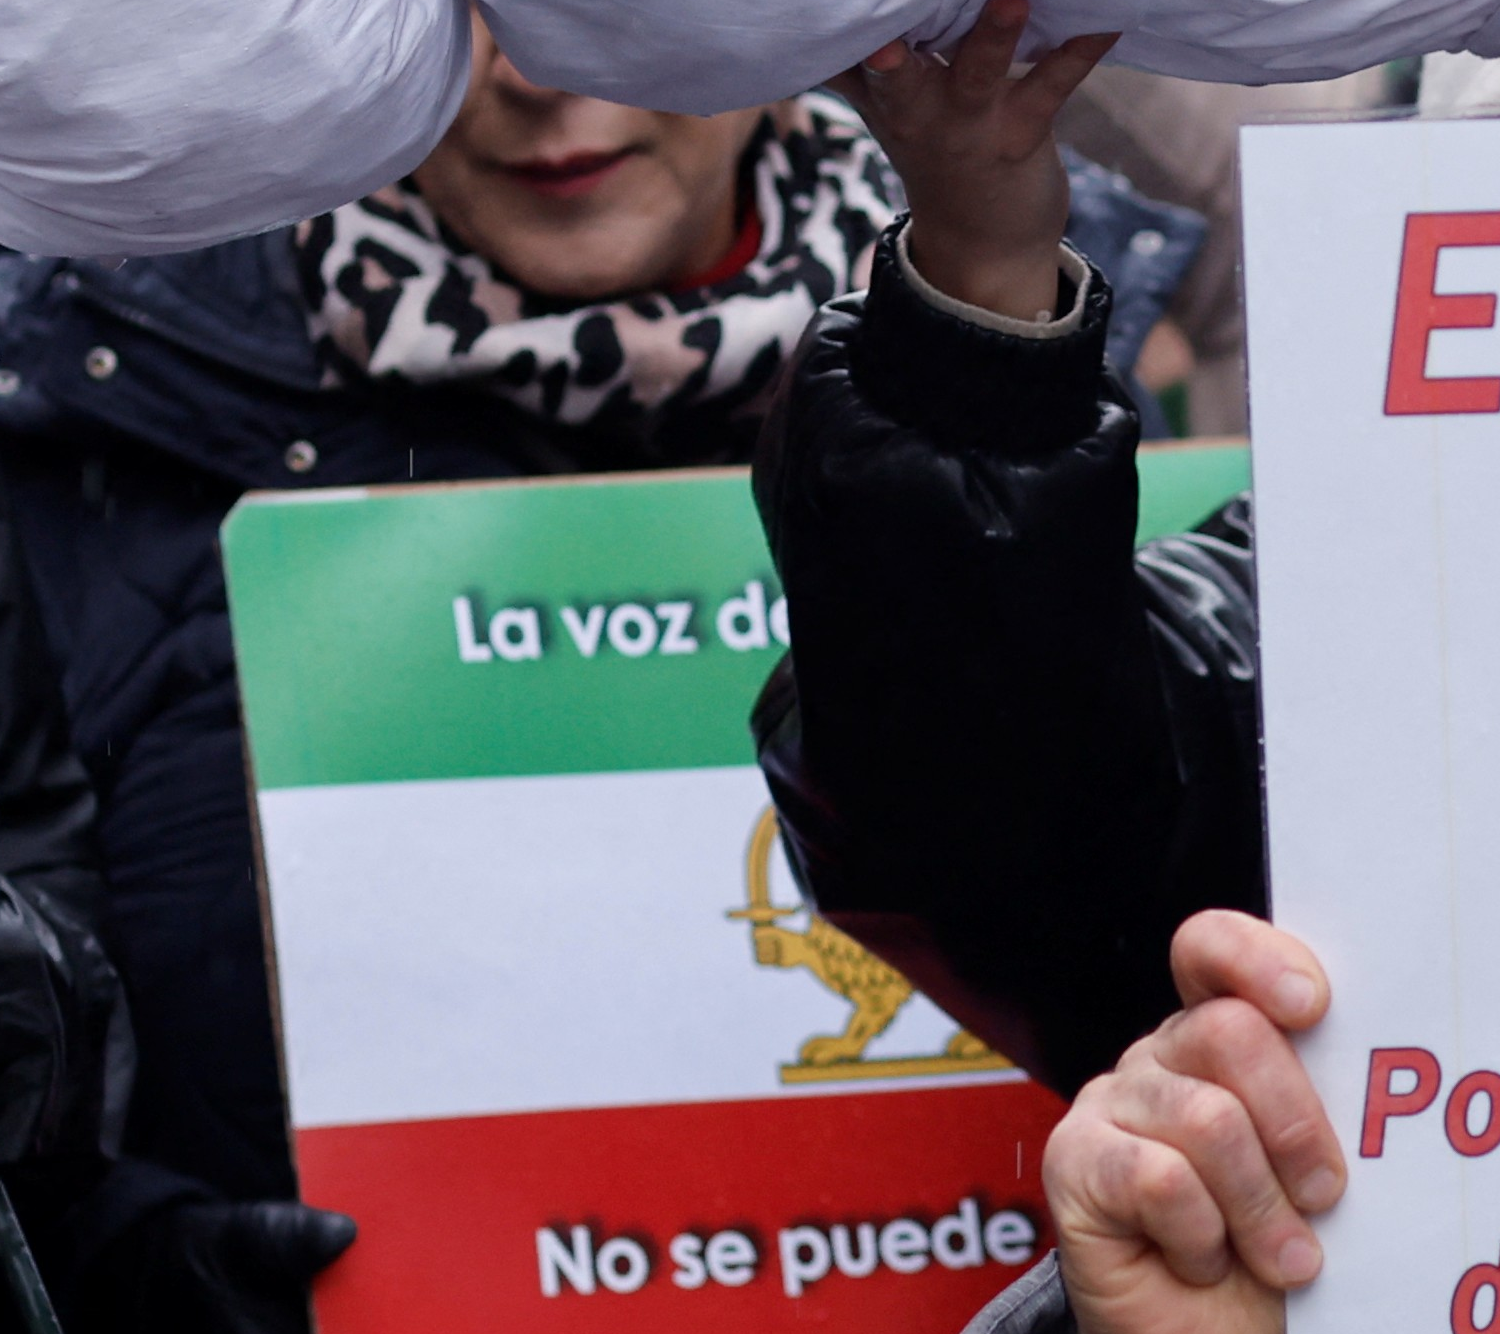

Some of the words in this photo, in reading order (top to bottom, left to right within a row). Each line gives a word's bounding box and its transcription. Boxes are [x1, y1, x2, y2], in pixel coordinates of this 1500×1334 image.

[453, 596, 541, 664] La
[560, 601, 697, 659] voz
[535, 1223, 648, 1298] No
[670, 1227, 758, 1292] se
[779, 1196, 1036, 1298] puede
